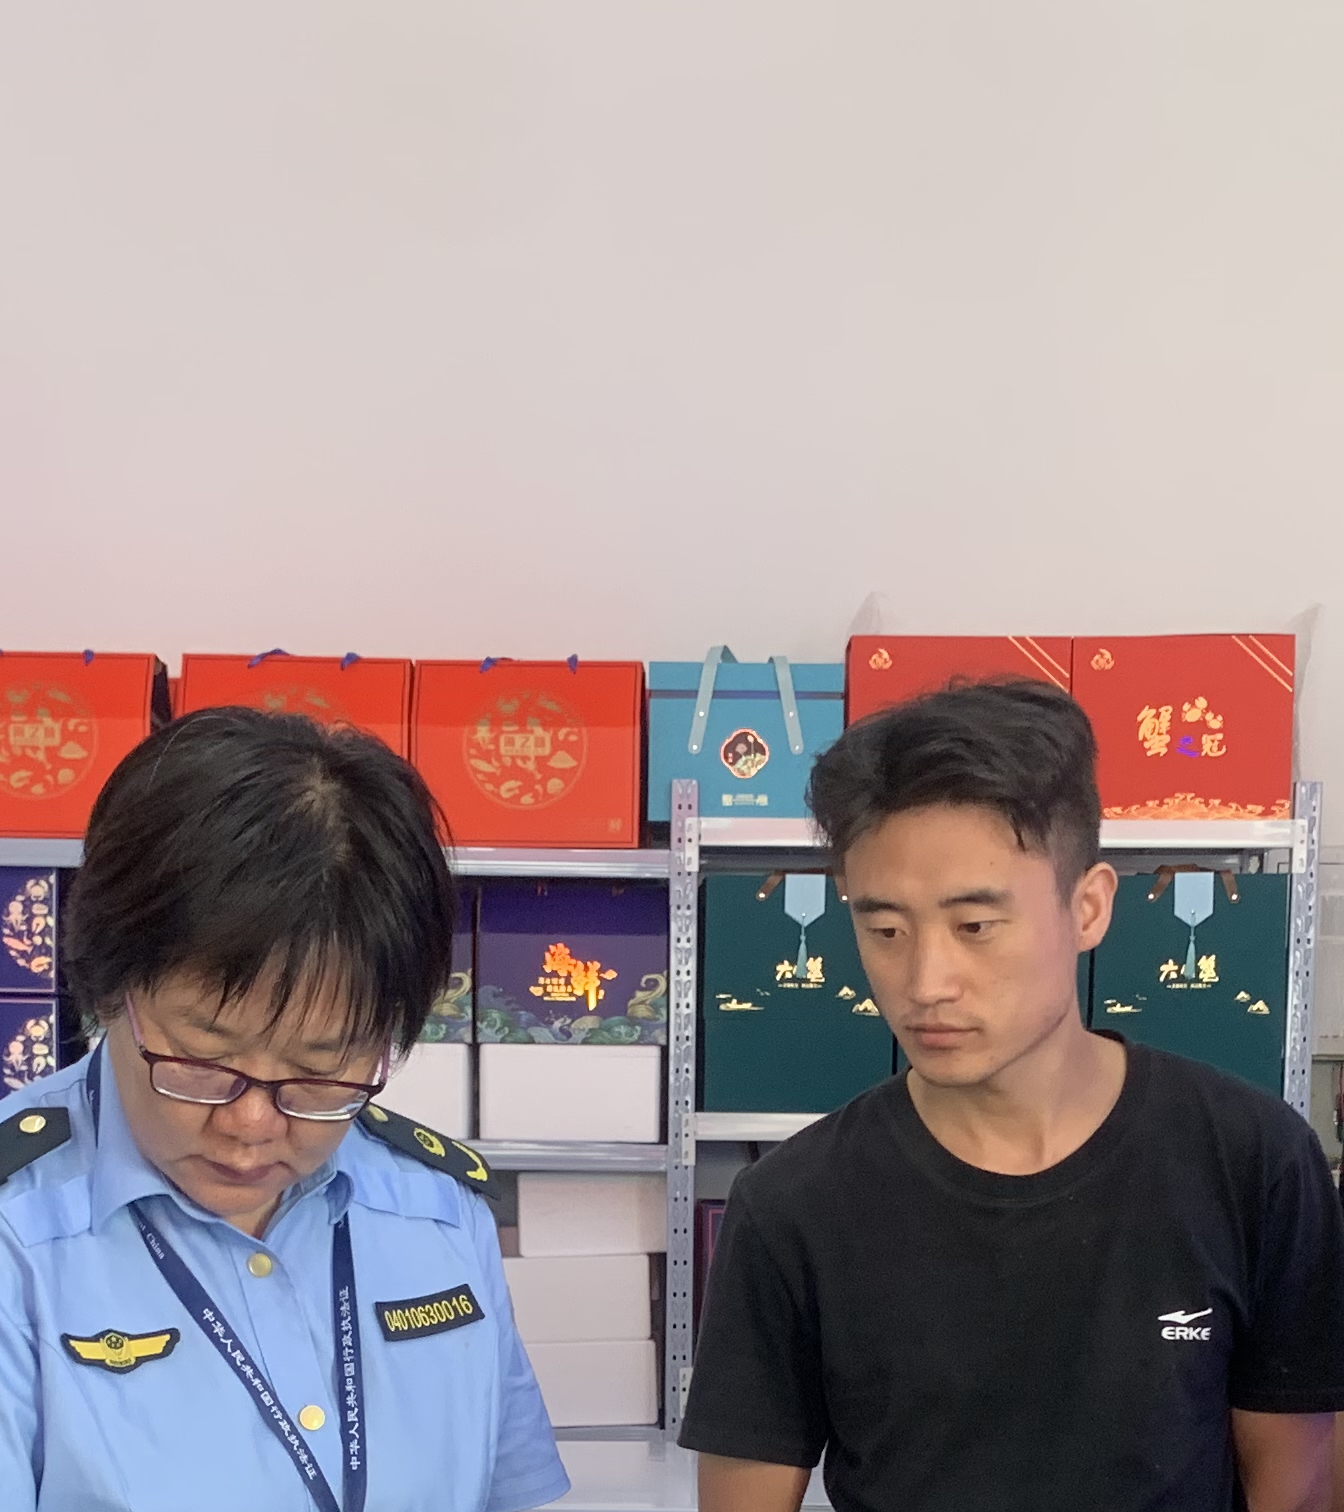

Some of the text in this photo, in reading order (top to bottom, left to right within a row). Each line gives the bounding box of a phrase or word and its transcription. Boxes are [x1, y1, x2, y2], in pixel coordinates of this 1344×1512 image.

[775, 956, 826, 982] 六蟹
[1159, 954, 1220, 982] 六蟹
[384, 1295, 473, 1331] 04010630016
[1161, 1326, 1212, 1341] ERKE
[340, 1285, 361, 1470] 中华人民共和国行政执法证
[202, 1308, 317, 1480] 中华人民共和国行政执法证
